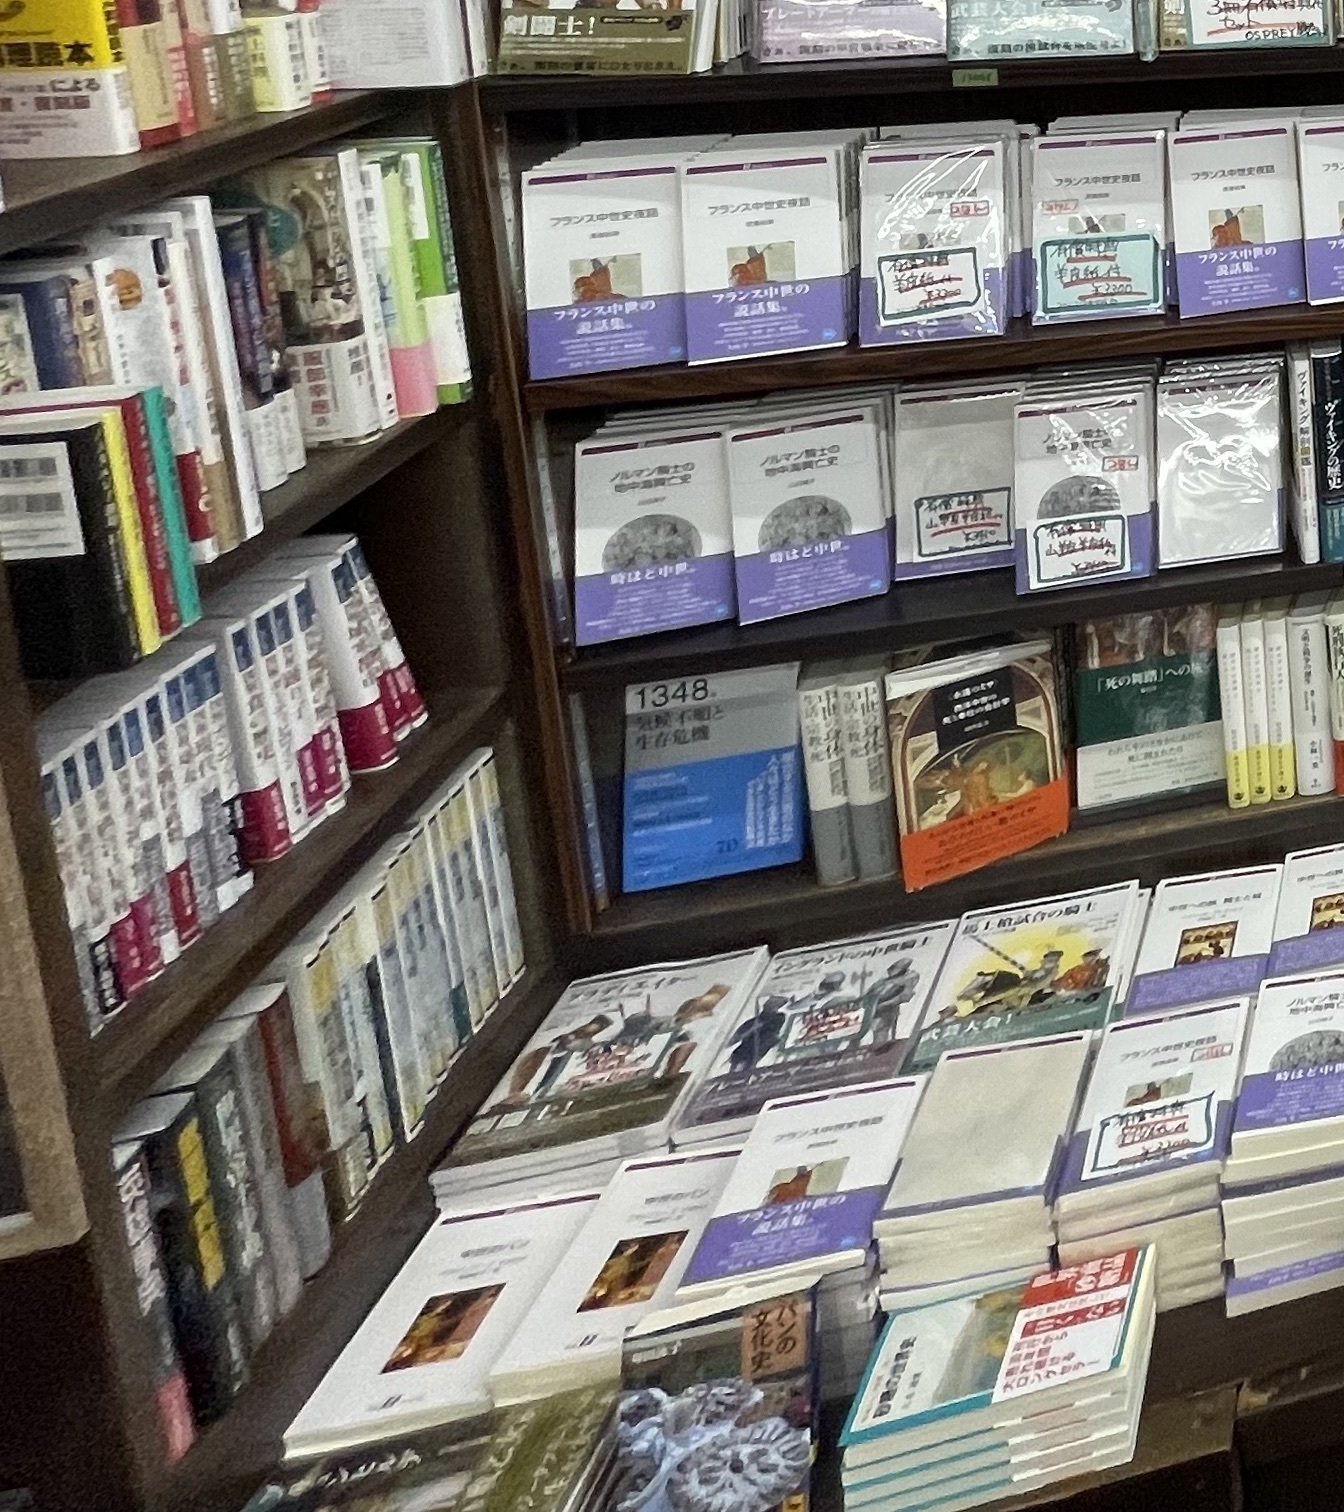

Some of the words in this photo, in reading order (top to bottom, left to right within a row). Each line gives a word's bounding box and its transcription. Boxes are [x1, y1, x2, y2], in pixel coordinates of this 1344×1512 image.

[1054, 172, 1141, 186] フランス中世史夜話
[708, 197, 811, 216] フランス中世史夜話
[550, 207, 659, 228] フランス中世史夜話
[1198, 245, 1277, 263] フランス中世の
[711, 283, 810, 304] フランス中世の
[554, 299, 656, 321] フランス中世の
[1324, 400, 1344, 490] ヴァイキングの歴史
[777, 1301, 797, 1354] パンの
[750, 1310, 775, 1371] 文化史
